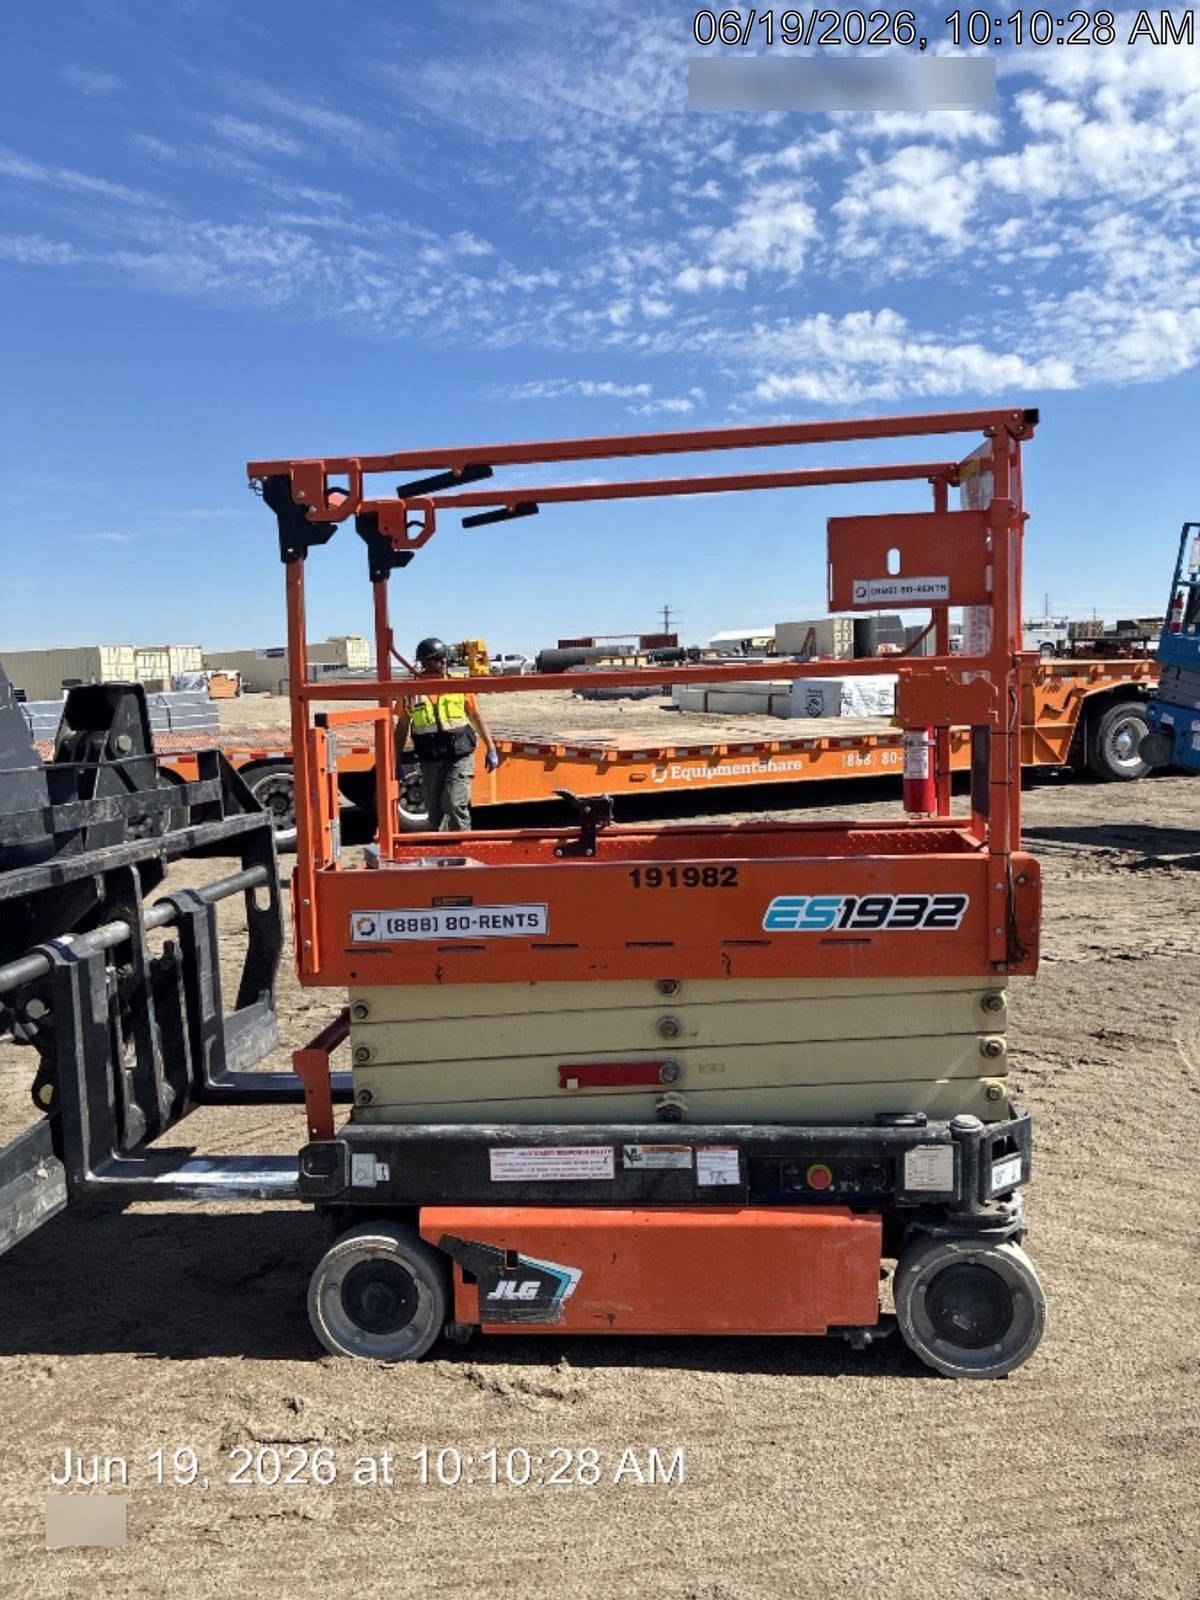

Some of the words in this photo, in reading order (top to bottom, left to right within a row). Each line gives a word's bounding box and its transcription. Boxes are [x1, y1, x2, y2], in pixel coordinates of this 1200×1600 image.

[628, 866, 739, 888] 191982
[446, 912, 539, 931] 80-RENTS
[763, 894, 970, 933] ES1932
[486, 1281, 541, 1300] JLG
